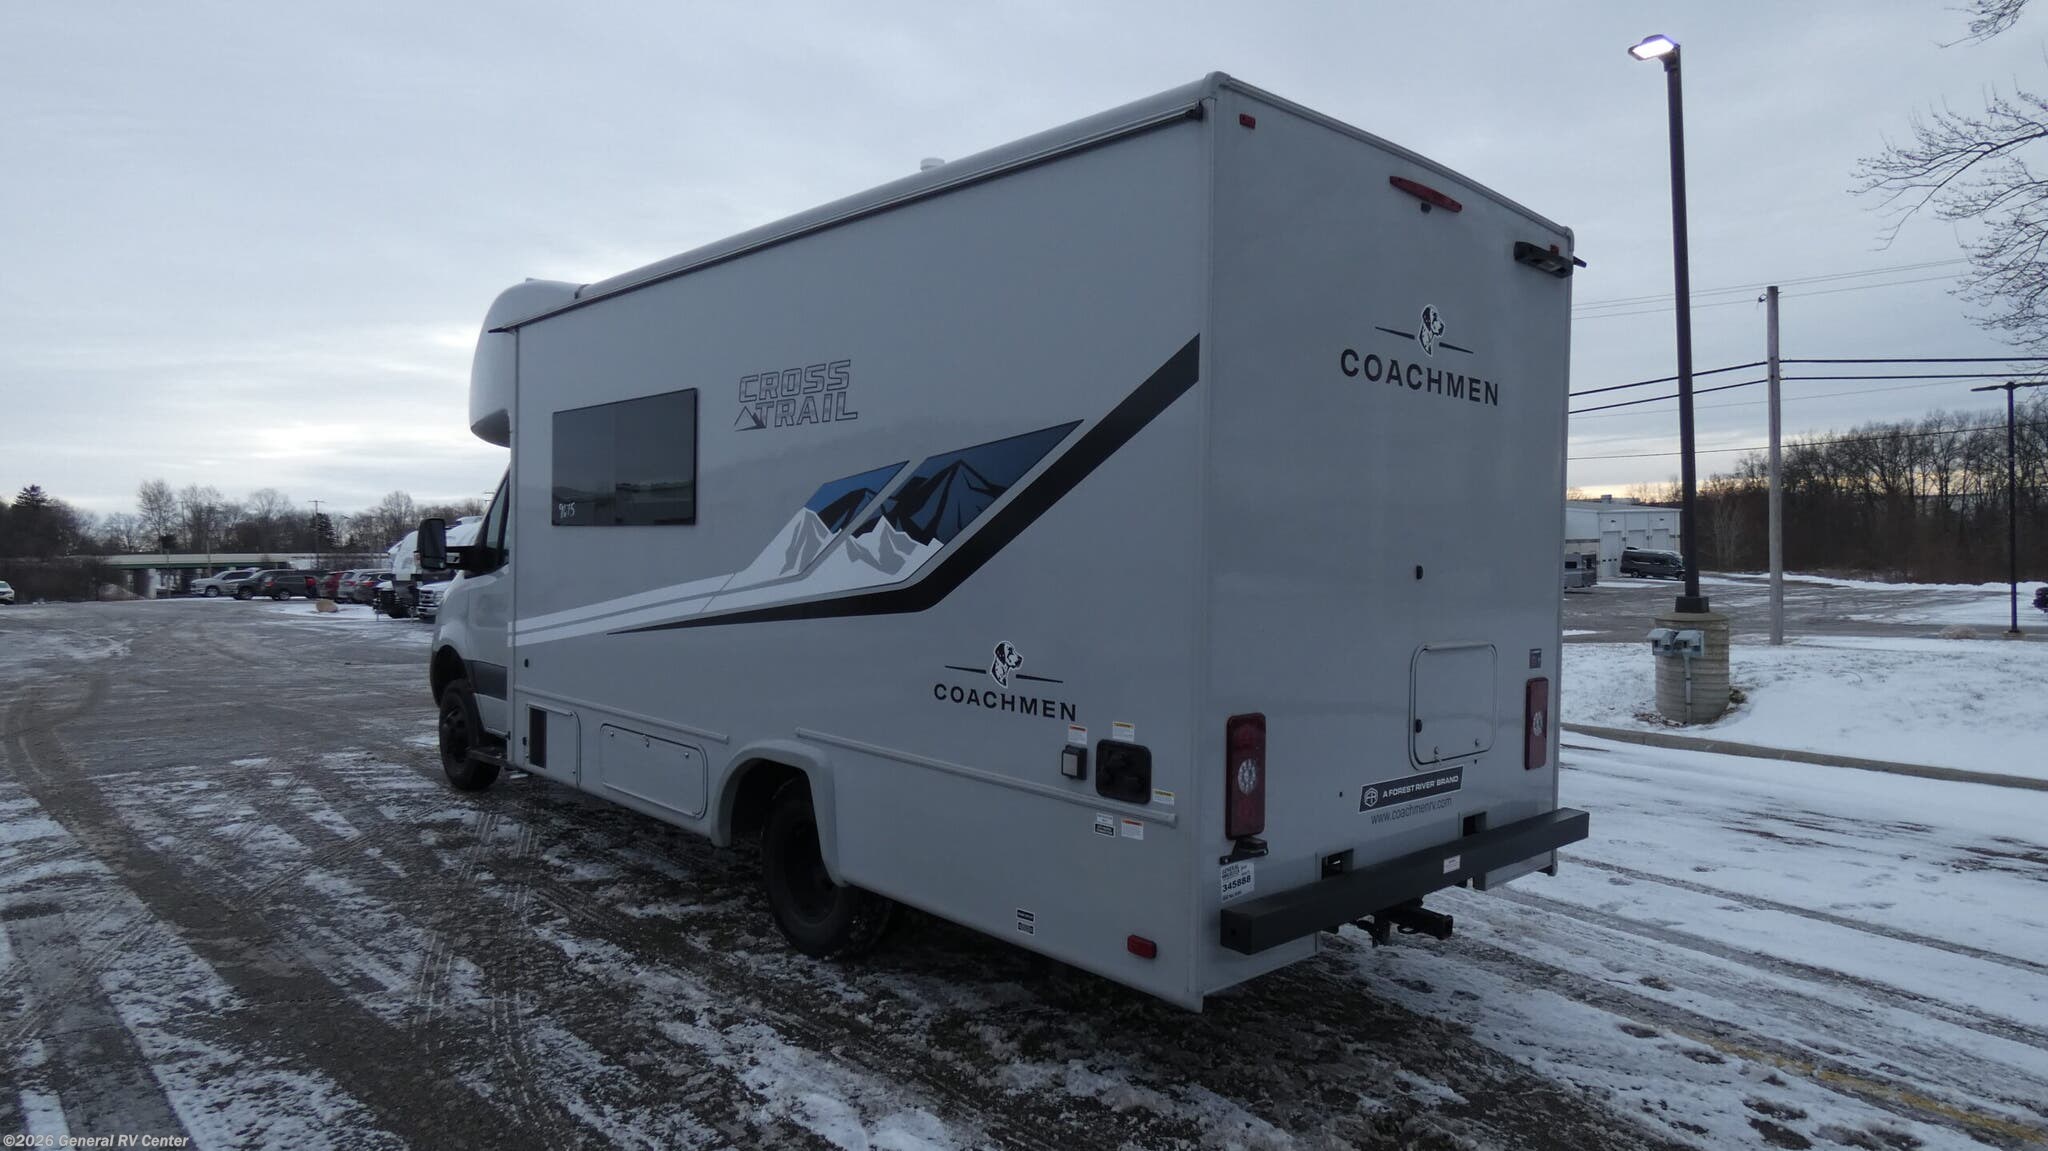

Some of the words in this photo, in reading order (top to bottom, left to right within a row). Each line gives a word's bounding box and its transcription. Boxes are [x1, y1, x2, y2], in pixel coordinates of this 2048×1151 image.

[738, 359, 851, 403] CROSS
[1340, 348, 1498, 407] COACHMEN
[755, 391, 858, 428] TRAIL
[934, 683, 1076, 722] COACHMEN
[1383, 790, 1389, 798] A
[1389, 784, 1414, 797] FOREST
[1415, 780, 1435, 792] RIVER
[1436, 775, 1459, 786] BRAND
[1370, 798, 1452, 824] www.coachmenrv.com
